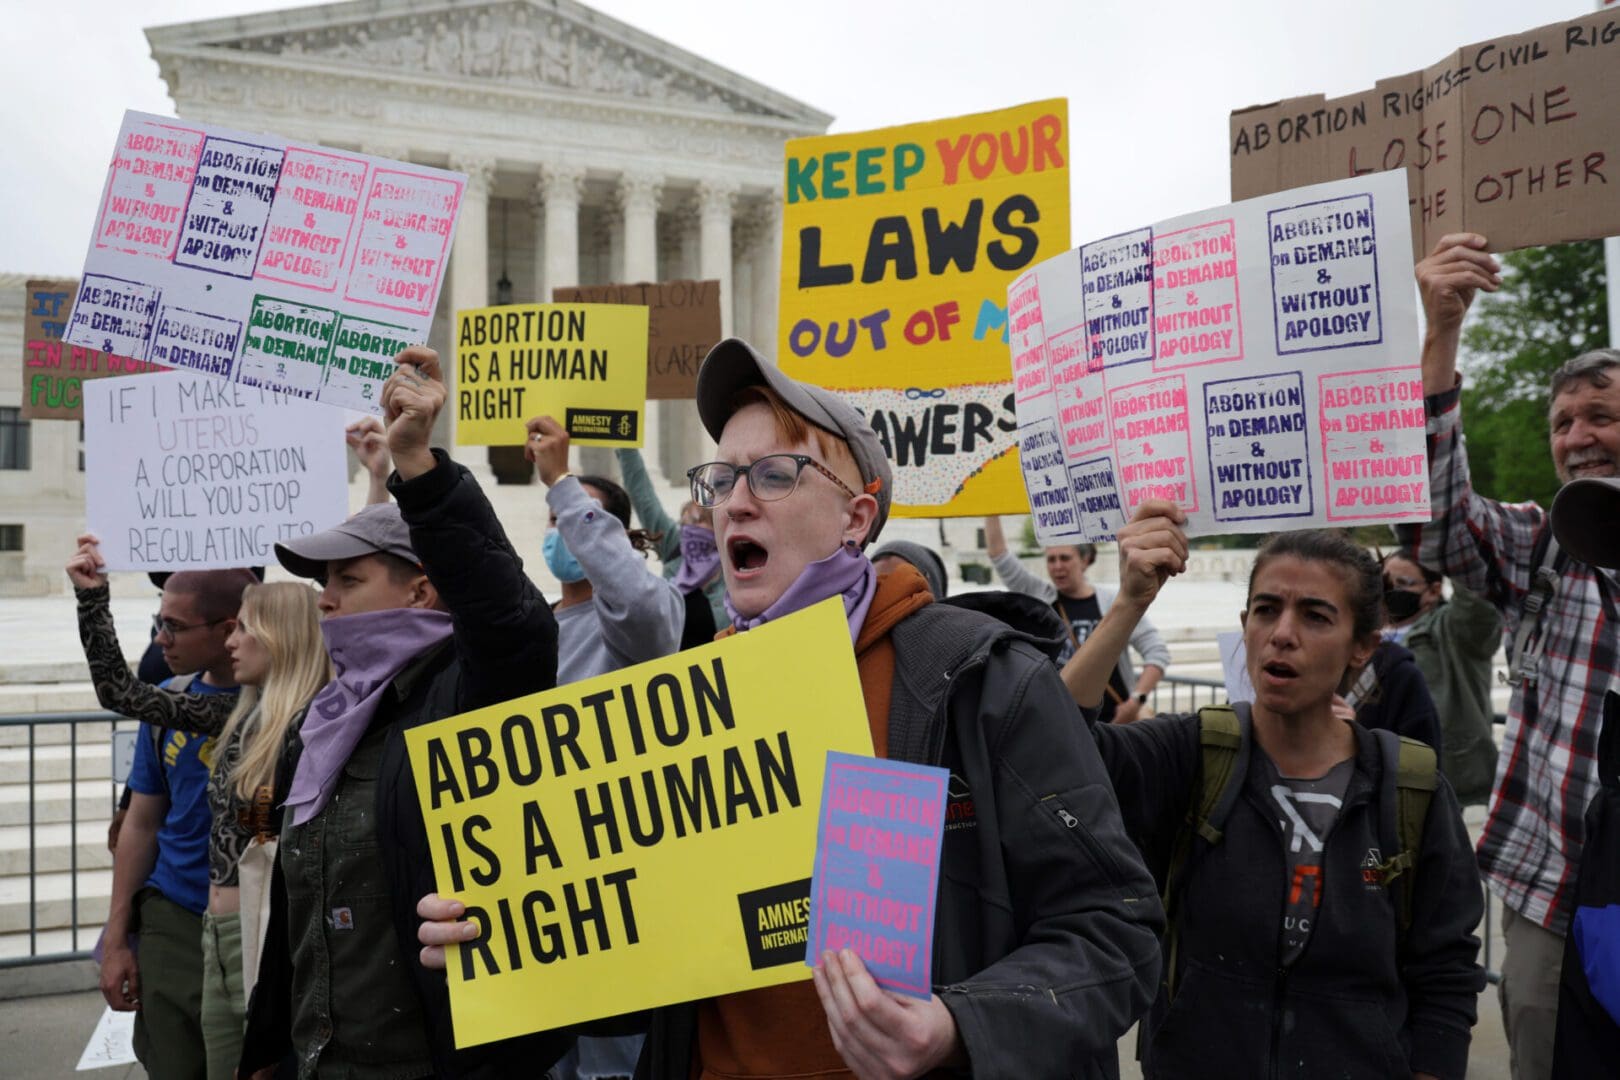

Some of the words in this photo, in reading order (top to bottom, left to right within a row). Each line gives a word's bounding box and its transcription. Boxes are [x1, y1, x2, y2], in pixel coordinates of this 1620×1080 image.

[1233, 101, 1367, 156] ABORTION
[1566, 21, 1620, 53] RIG
[1349, 121, 1448, 177] LOSE
[1471, 86, 1578, 145] ONE
[126, 133, 201, 161] ABORTION
[787, 143, 925, 204] KEEP
[936, 113, 1065, 186] YOUR
[132, 158, 198, 183] DEMAND
[202, 150, 281, 179] ABORTION
[1474, 152, 1607, 204] OTHER
[212, 175, 275, 203] DEMAND
[294, 186, 358, 216] DEMAND
[112, 196, 180, 223] WITHOUT
[223, 201, 235, 215] &
[304, 213, 316, 229] &
[105, 220, 173, 248] APOLOGY
[190, 214, 258, 242] WITHOUT
[270, 224, 341, 255] WITHOUT
[1274, 209, 1370, 242] ABORTION
[395, 235, 407, 249] &
[798, 194, 1040, 290] LAWS
[1084, 239, 1150, 272] ABORTION
[1152, 234, 1231, 267] ABORTION
[1272, 253, 1290, 266] on
[1294, 235, 1373, 265] DEMAND
[1082, 282, 1095, 294] on
[1097, 263, 1153, 293] DEMAND
[1167, 259, 1236, 288] DEMAND
[1317, 268, 1331, 284] &
[81, 286, 155, 316] ABORTION
[1112, 295, 1122, 309] &
[1186, 290, 1199, 306] &
[1281, 283, 1371, 313] WITHOUT
[91, 312, 152, 341] DEMAND
[252, 310, 333, 341] ABORTION
[460, 310, 586, 347] ABORTION
[789, 308, 891, 358] OUT
[903, 301, 961, 345] OF
[974, 299, 1009, 344] M
[1089, 307, 1149, 336] WITHOUT
[1156, 304, 1233, 333] WITHOUT
[1285, 311, 1371, 341] APOLOGY
[102, 339, 113, 353] &
[160, 320, 236, 351] ABORTION
[262, 335, 328, 365] DEMAND
[1092, 331, 1148, 360] APOLOGY
[1160, 329, 1232, 359] APOLOGY
[27, 340, 63, 368] IN
[154, 345, 167, 359] on
[169, 346, 232, 376] DEMAND
[348, 356, 398, 381] DEMA
[461, 352, 480, 383] IS
[488, 351, 501, 382] A
[510, 348, 608, 381] HUMAN
[31, 374, 81, 408] FUC
[109, 387, 136, 423] IF
[152, 386, 158, 418] I
[178, 380, 246, 413] MAKE
[460, 387, 526, 420] RIGHT
[1113, 388, 1186, 419] ABORTION
[1208, 387, 1301, 414] ABORTION
[1324, 380, 1424, 408] ABORTION
[572, 414, 612, 427] AMNESTY
[1062, 396, 1103, 424] WITHOUT
[1322, 418, 1342, 432] on
[1346, 407, 1425, 433] DEMAND
[157, 414, 259, 451] UTERUS
[572, 425, 611, 435] INTERNATIONAL
[857, 392, 1017, 467] AWERS
[1067, 420, 1104, 447] APOLOGY
[1127, 412, 1188, 440] DEMAND
[1208, 424, 1225, 437] on
[1229, 413, 1304, 438] DEMAND
[1143, 442, 1153, 456] &
[1251, 441, 1265, 457] &
[1370, 437, 1384, 453] &
[135, 458, 150, 487] A
[162, 446, 307, 487] CORPORATION
[1122, 457, 1185, 484] WITHOUT
[1217, 459, 1302, 483] WITHOUT
[1332, 454, 1424, 480] WITHOUT
[1074, 470, 1113, 493] ABORTION
[137, 489, 197, 520] WILL
[202, 486, 242, 516] YOU
[248, 480, 301, 514] STOP
[1033, 487, 1070, 508] WITHOUT
[1086, 493, 1120, 513] DEMAND
[1222, 484, 1302, 509] APOLOGY
[1038, 508, 1074, 528] APOLOGY
[129, 525, 270, 563] REGULATING
[425, 656, 736, 811] ABORTION
[440, 814, 501, 894] IS
[522, 800, 563, 876] A
[574, 731, 801, 860] HUMAN
[831, 783, 936, 828] ABORTION
[849, 824, 936, 866] DEMAND
[866, 860, 883, 889] &
[758, 897, 811, 932] AMNES
[827, 884, 922, 933] WITHOUT
[460, 867, 640, 981] RIGHT
[760, 926, 809, 952] INTERNAT
[825, 923, 918, 973] APOLOGY
